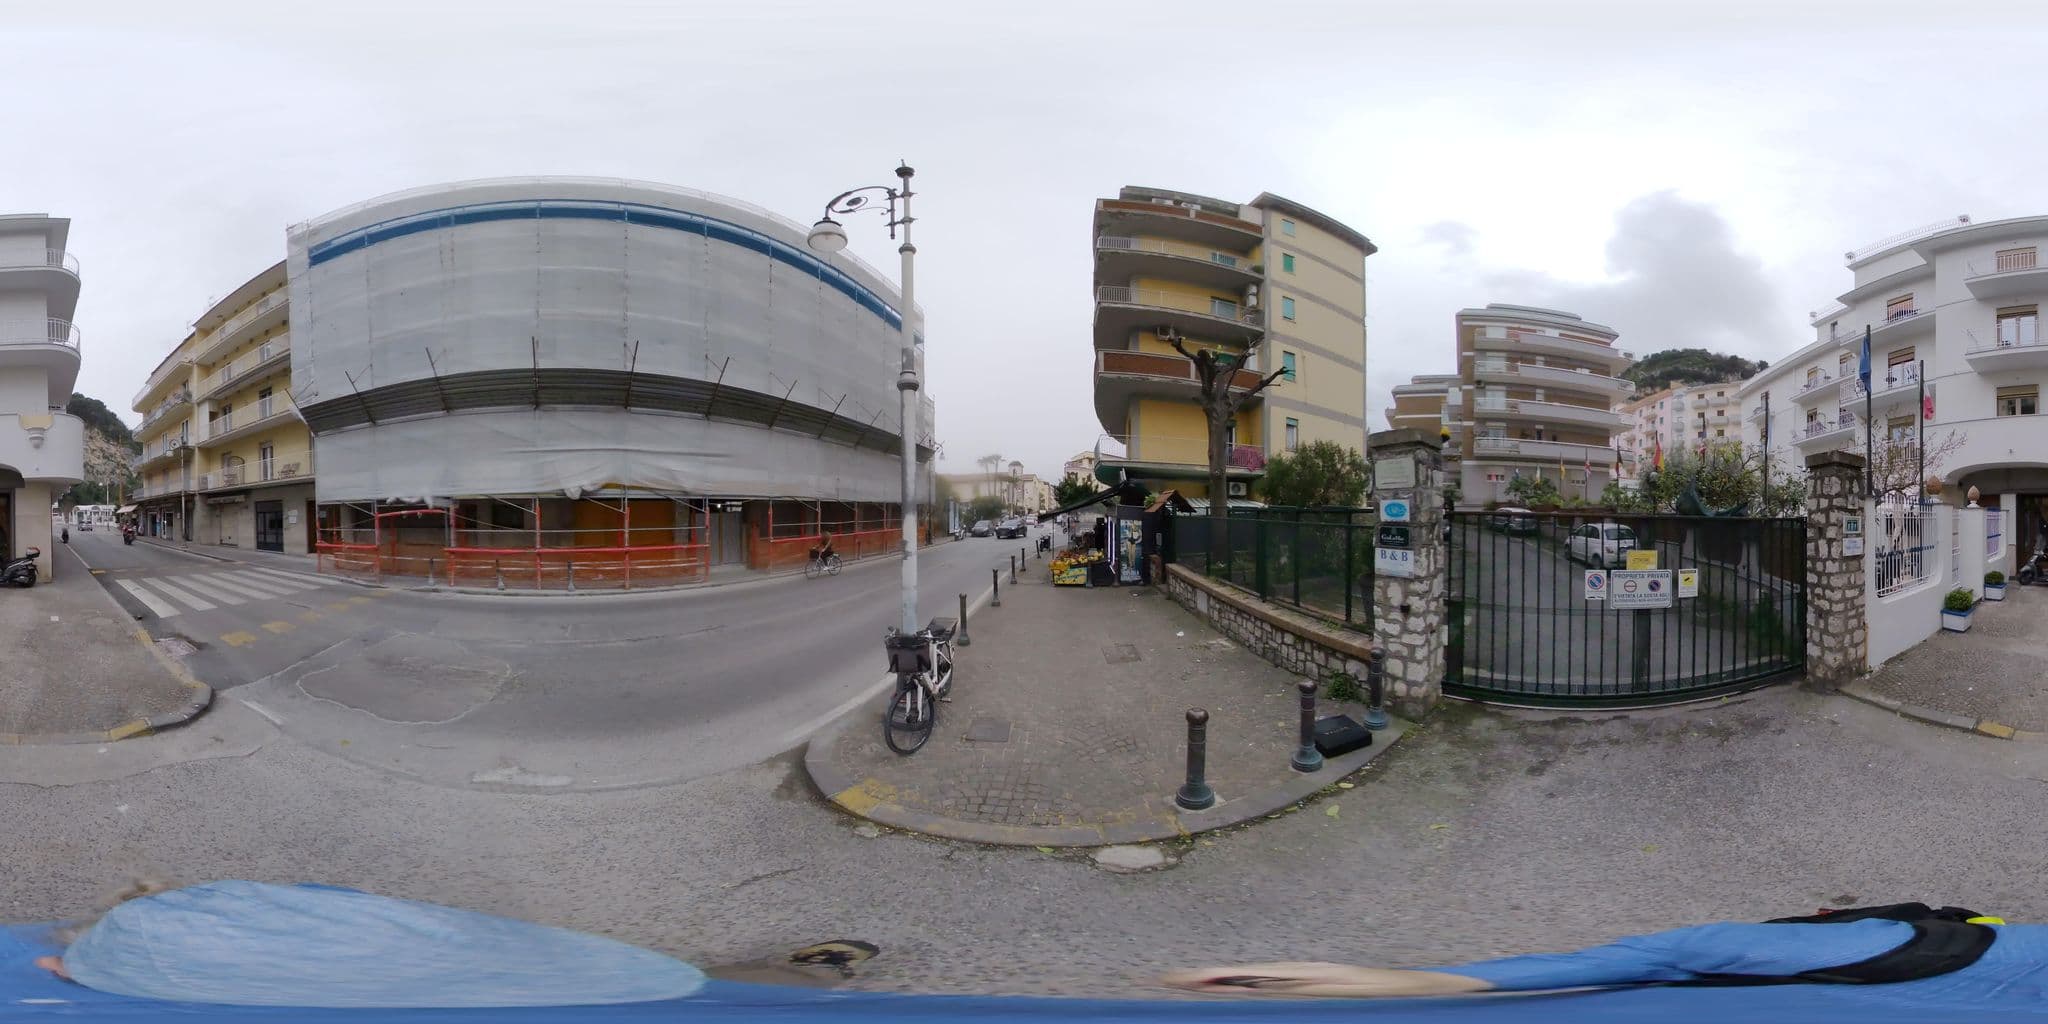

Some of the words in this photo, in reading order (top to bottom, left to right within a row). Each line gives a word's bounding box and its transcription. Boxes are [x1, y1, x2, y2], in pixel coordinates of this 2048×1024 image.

[1380, 549, 1387, 560] B
[1389, 551, 1398, 561] &
[1401, 551, 1409, 562] B
